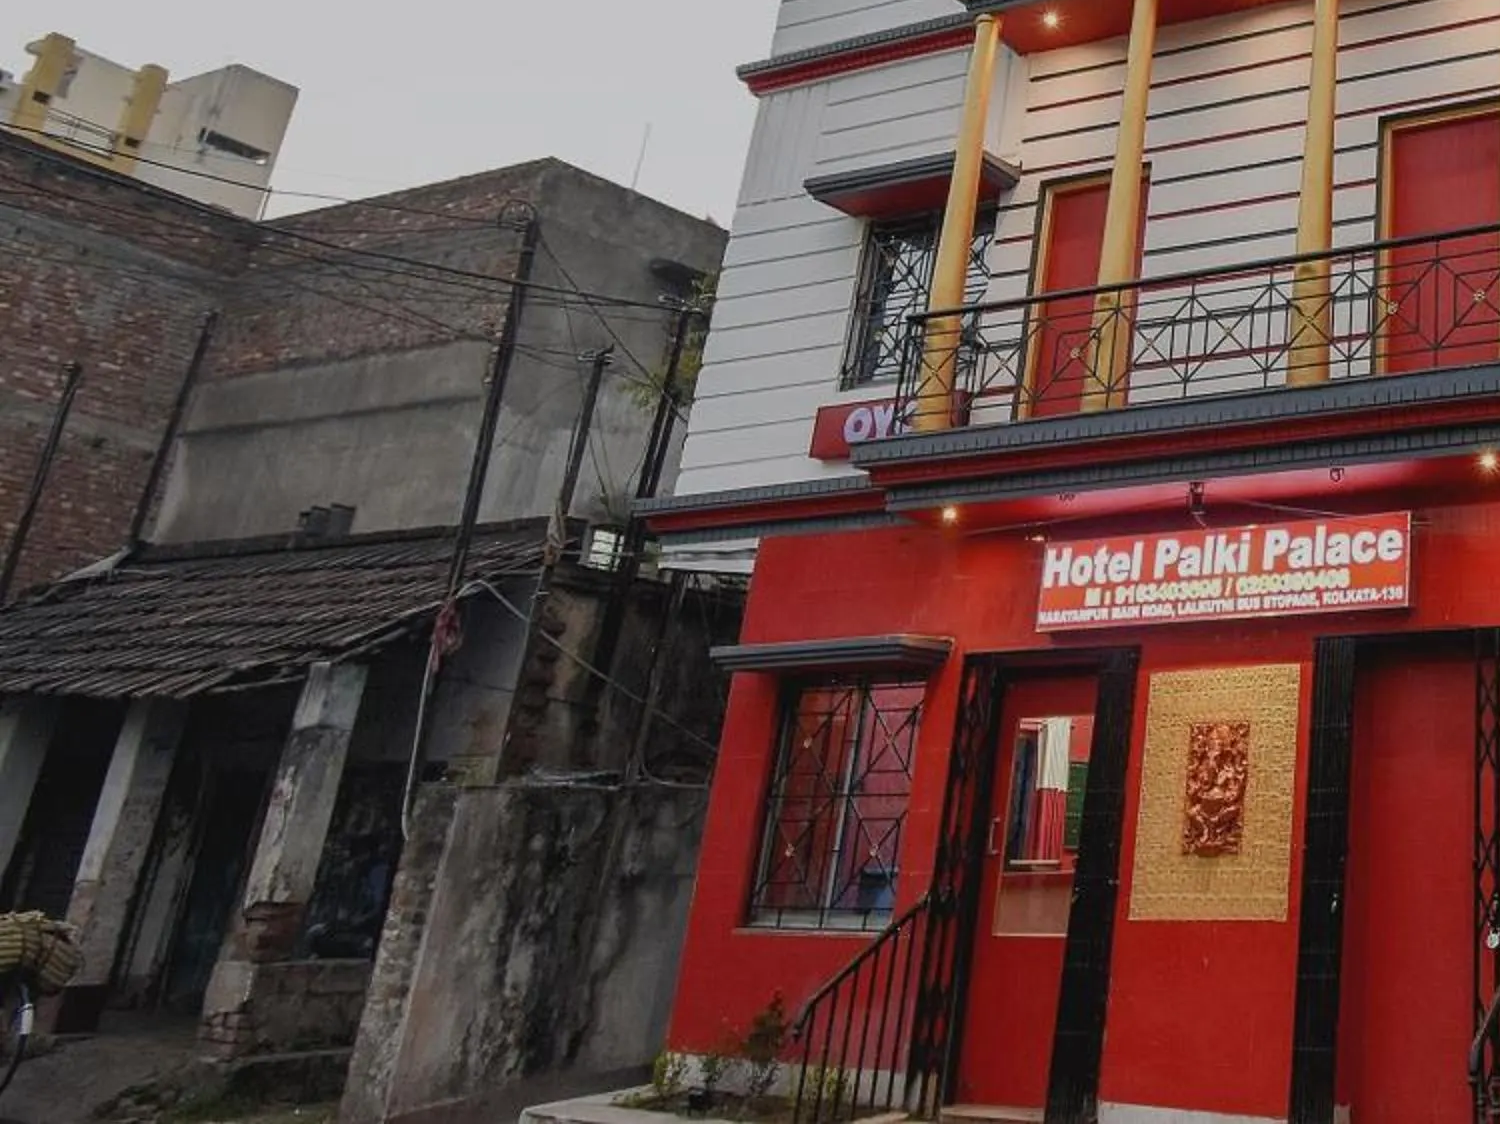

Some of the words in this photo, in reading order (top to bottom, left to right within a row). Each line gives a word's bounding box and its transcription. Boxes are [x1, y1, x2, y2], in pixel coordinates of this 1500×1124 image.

[1042, 540, 1145, 589] Hotel
[1153, 531, 1252, 579] Palki
[1262, 525, 1405, 571] Palace
